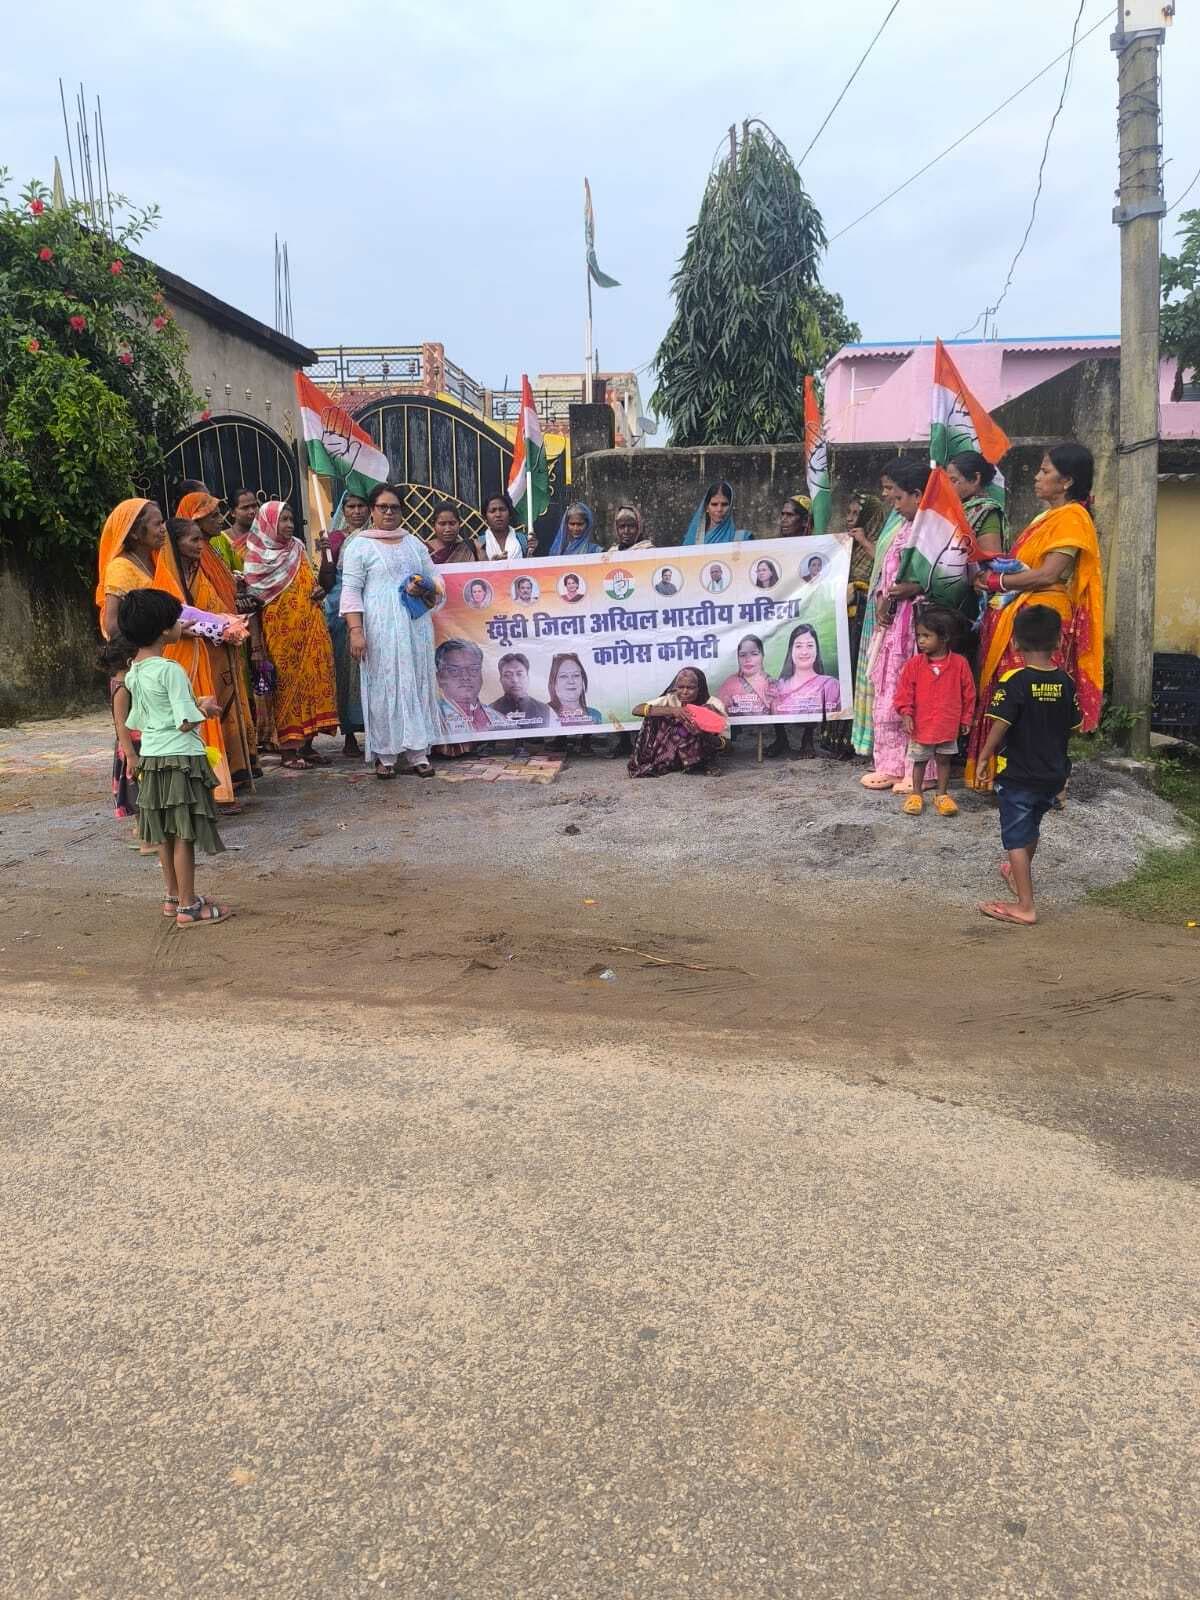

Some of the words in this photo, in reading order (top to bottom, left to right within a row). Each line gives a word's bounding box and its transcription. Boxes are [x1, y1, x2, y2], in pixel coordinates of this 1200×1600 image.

[534, 612, 586, 637] जिला
[590, 606, 658, 632] अखिल
[662, 603, 734, 629] भारतीय
[738, 596, 802, 622] महिला
[592, 638, 653, 666] कांग्रेस
[657, 634, 720, 662] कमिटी
